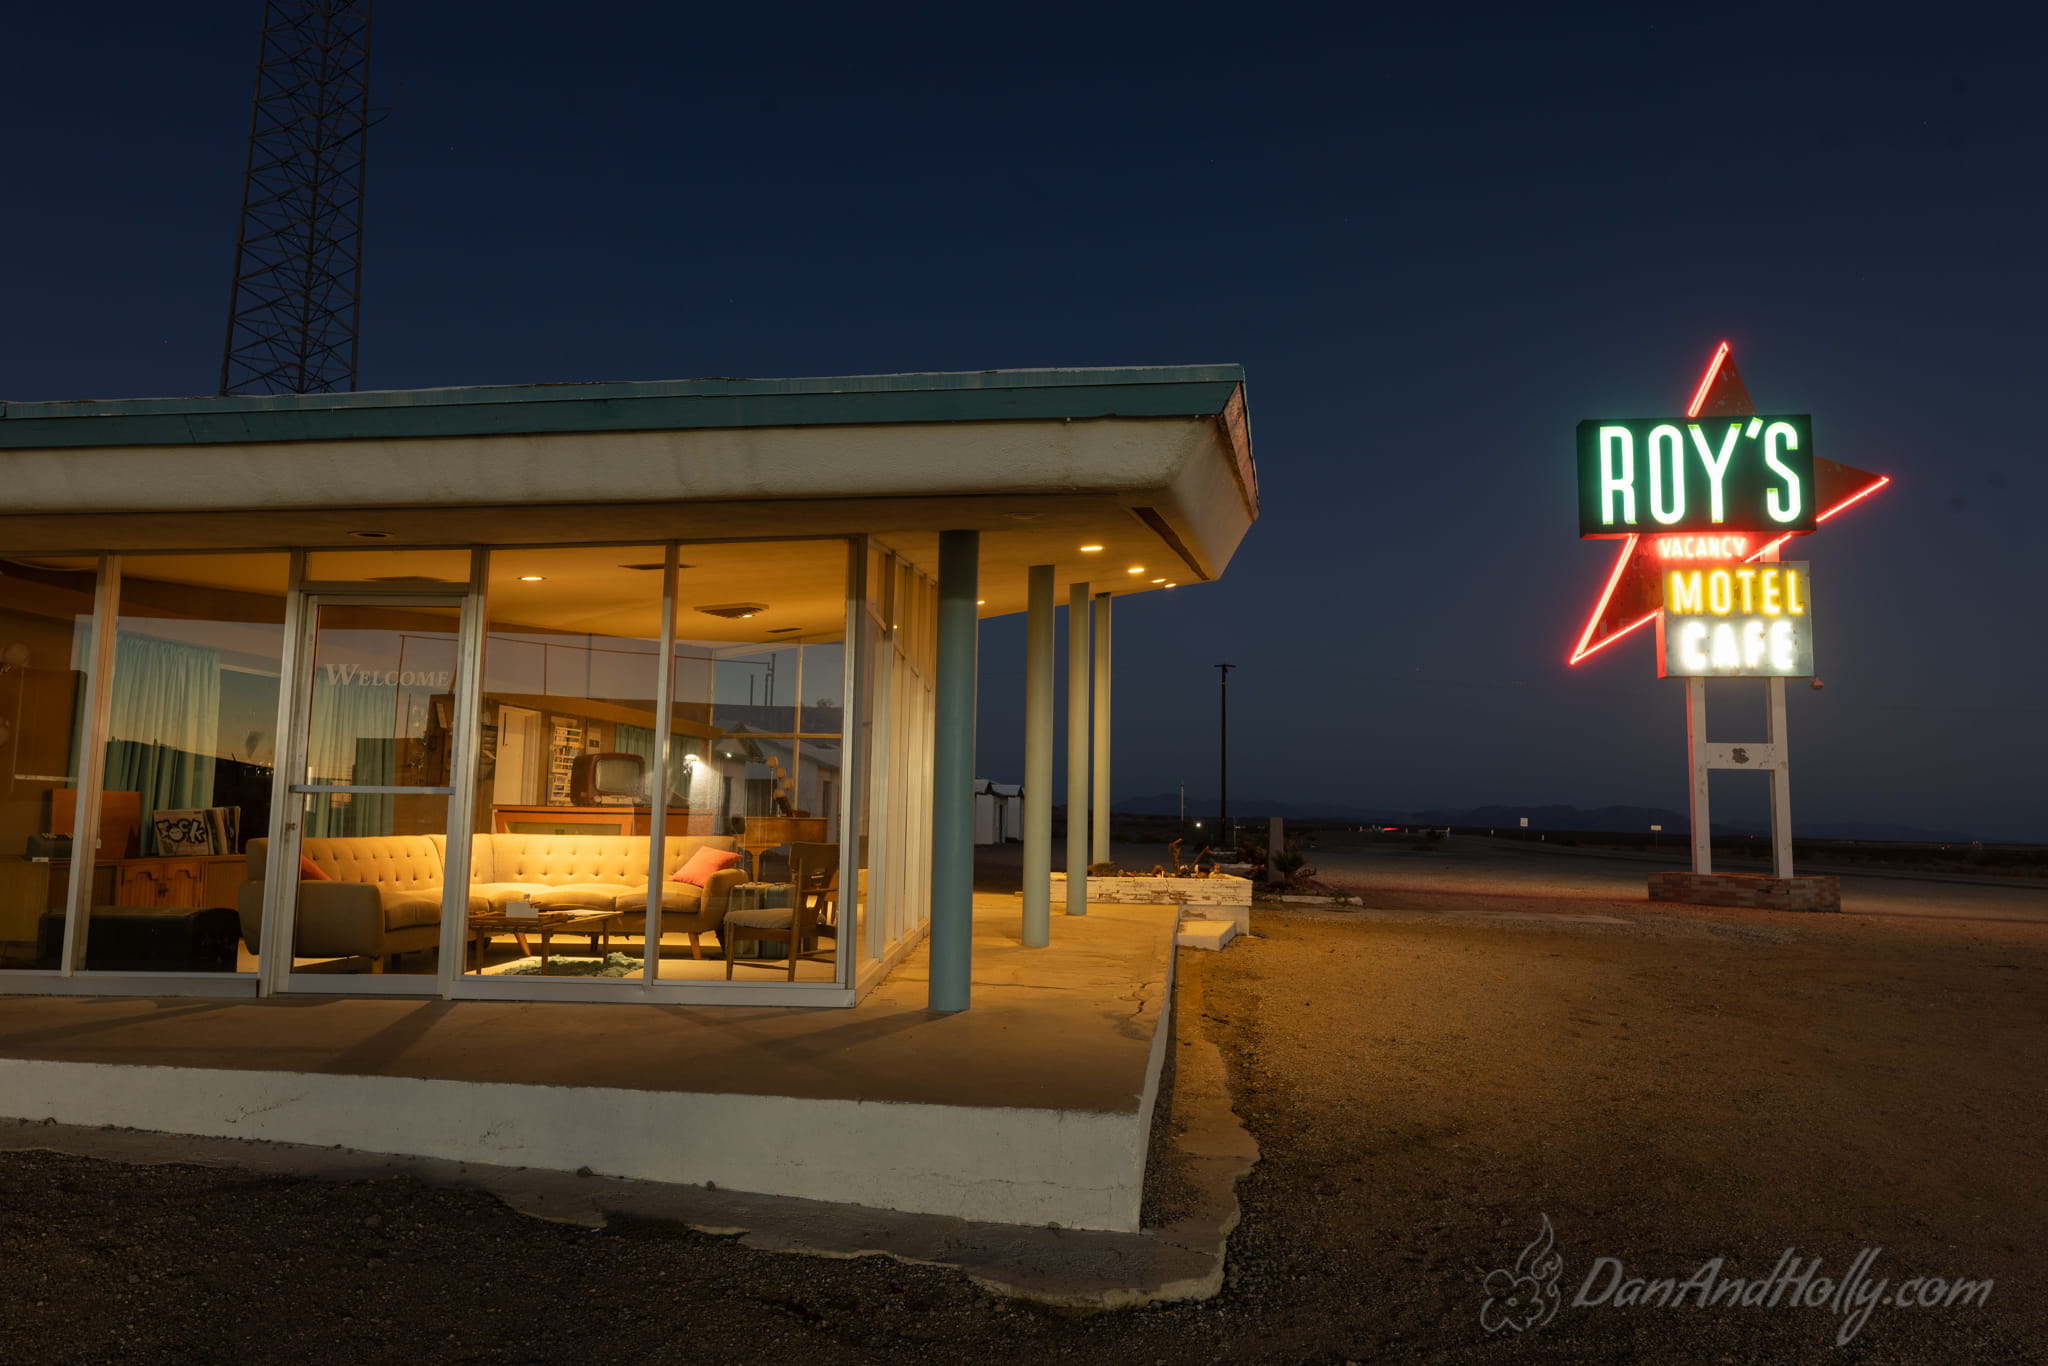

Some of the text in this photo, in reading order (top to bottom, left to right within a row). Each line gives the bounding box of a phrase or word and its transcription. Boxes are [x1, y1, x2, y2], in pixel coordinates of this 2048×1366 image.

[1599, 417, 1802, 525] ROY'S
[1658, 536, 1747, 559] VACANCY
[1669, 568, 1805, 616] MOTEL
[1680, 620, 1795, 671] CAFE
